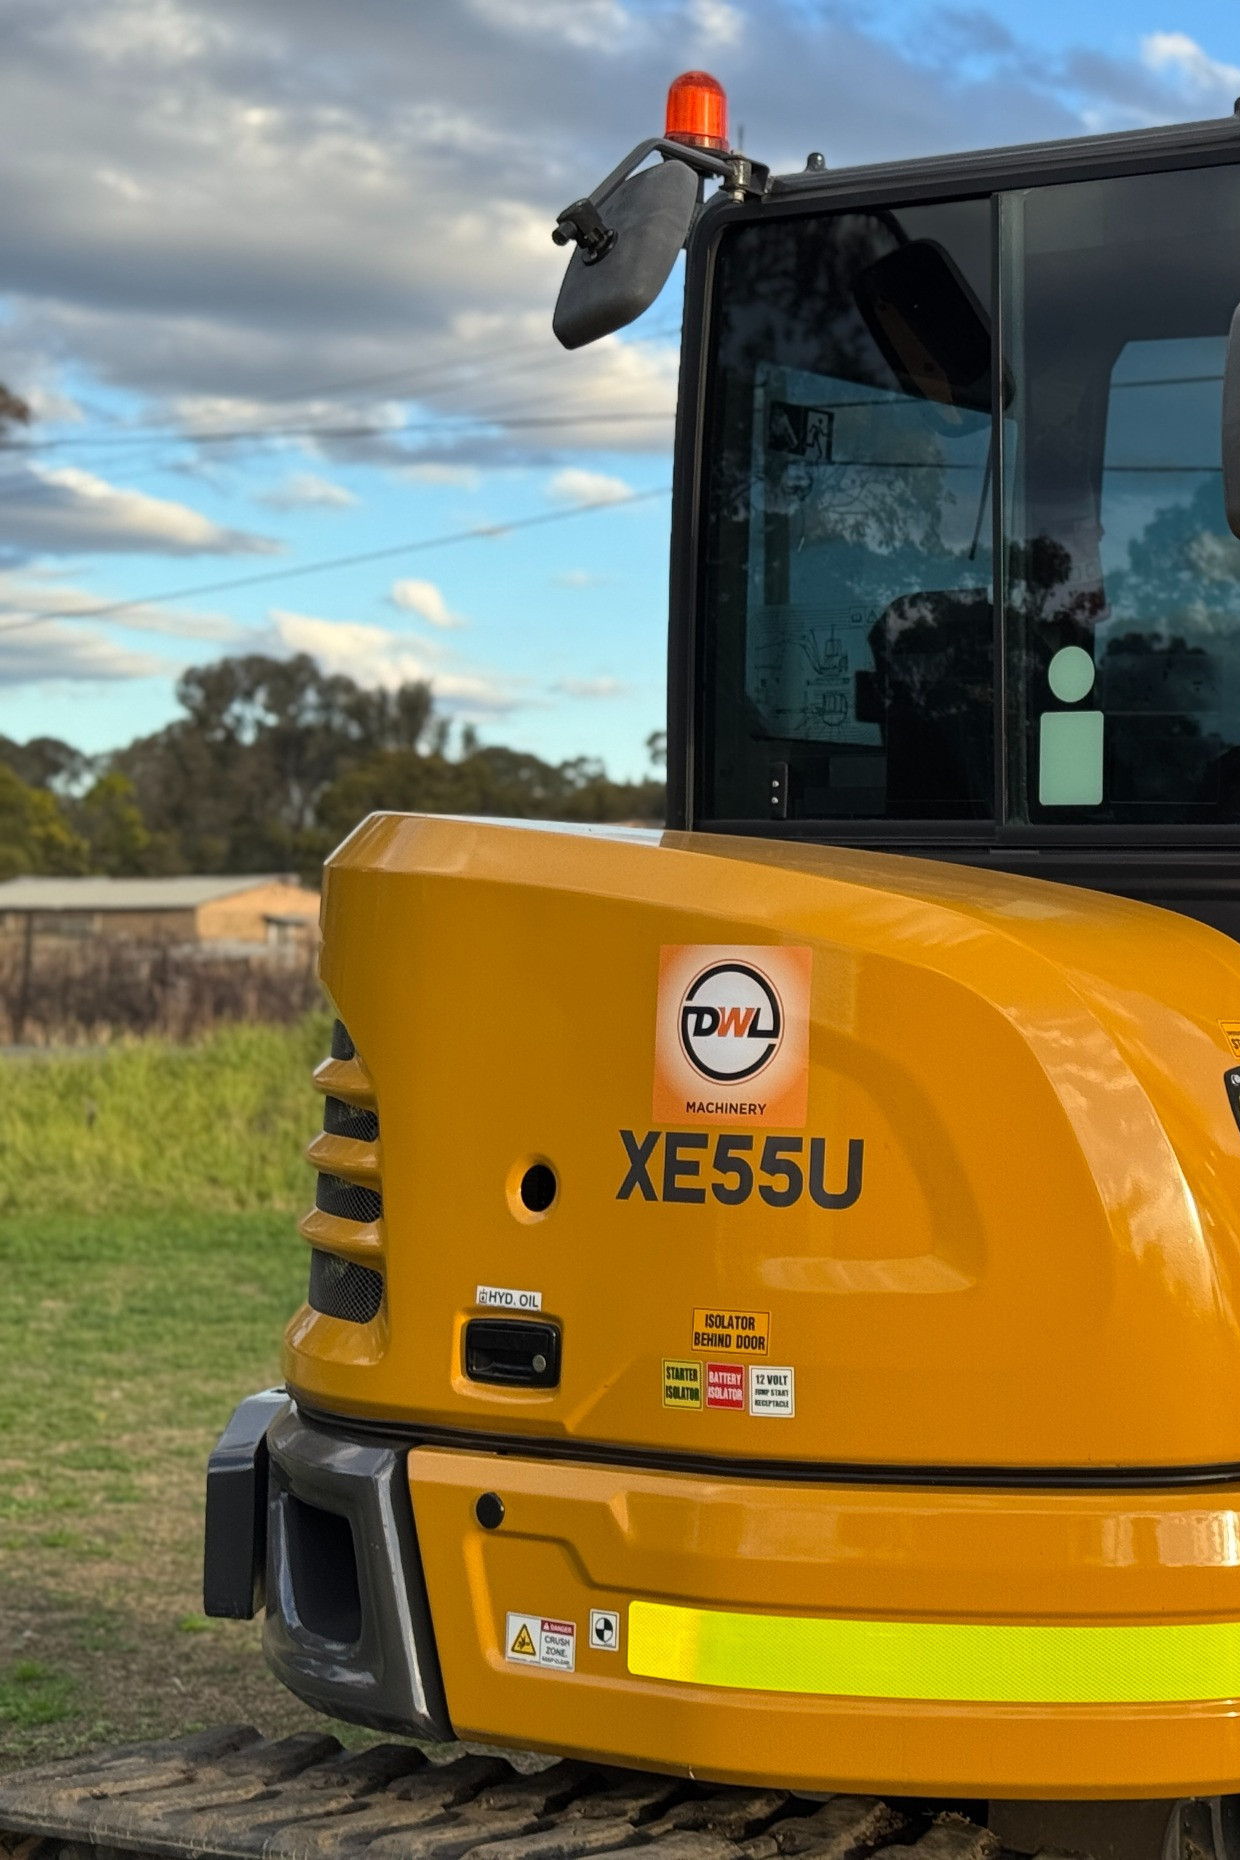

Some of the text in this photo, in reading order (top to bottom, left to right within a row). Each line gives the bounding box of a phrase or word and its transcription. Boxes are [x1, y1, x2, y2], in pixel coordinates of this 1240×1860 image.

[685, 1101, 767, 1116] MACHINERY
[615, 1129, 864, 1210] XE55U
[488, 1290, 539, 1308] HYD. OIL
[705, 1313, 755, 1330] ISOLATOR
[694, 1332, 766, 1350] BEHIND DOOR
[666, 1366, 698, 1381] STARTER
[708, 1371, 742, 1385] BATTERY
[756, 1374, 788, 1386] 12 VOLT
[665, 1385, 700, 1401] ISOLATOR
[708, 1386, 743, 1401] ISOLATOR
[549, 1623, 572, 1633] DANGER
[544, 1635, 570, 1646] CRUSH
[545, 1646, 567, 1657] ZONE.
